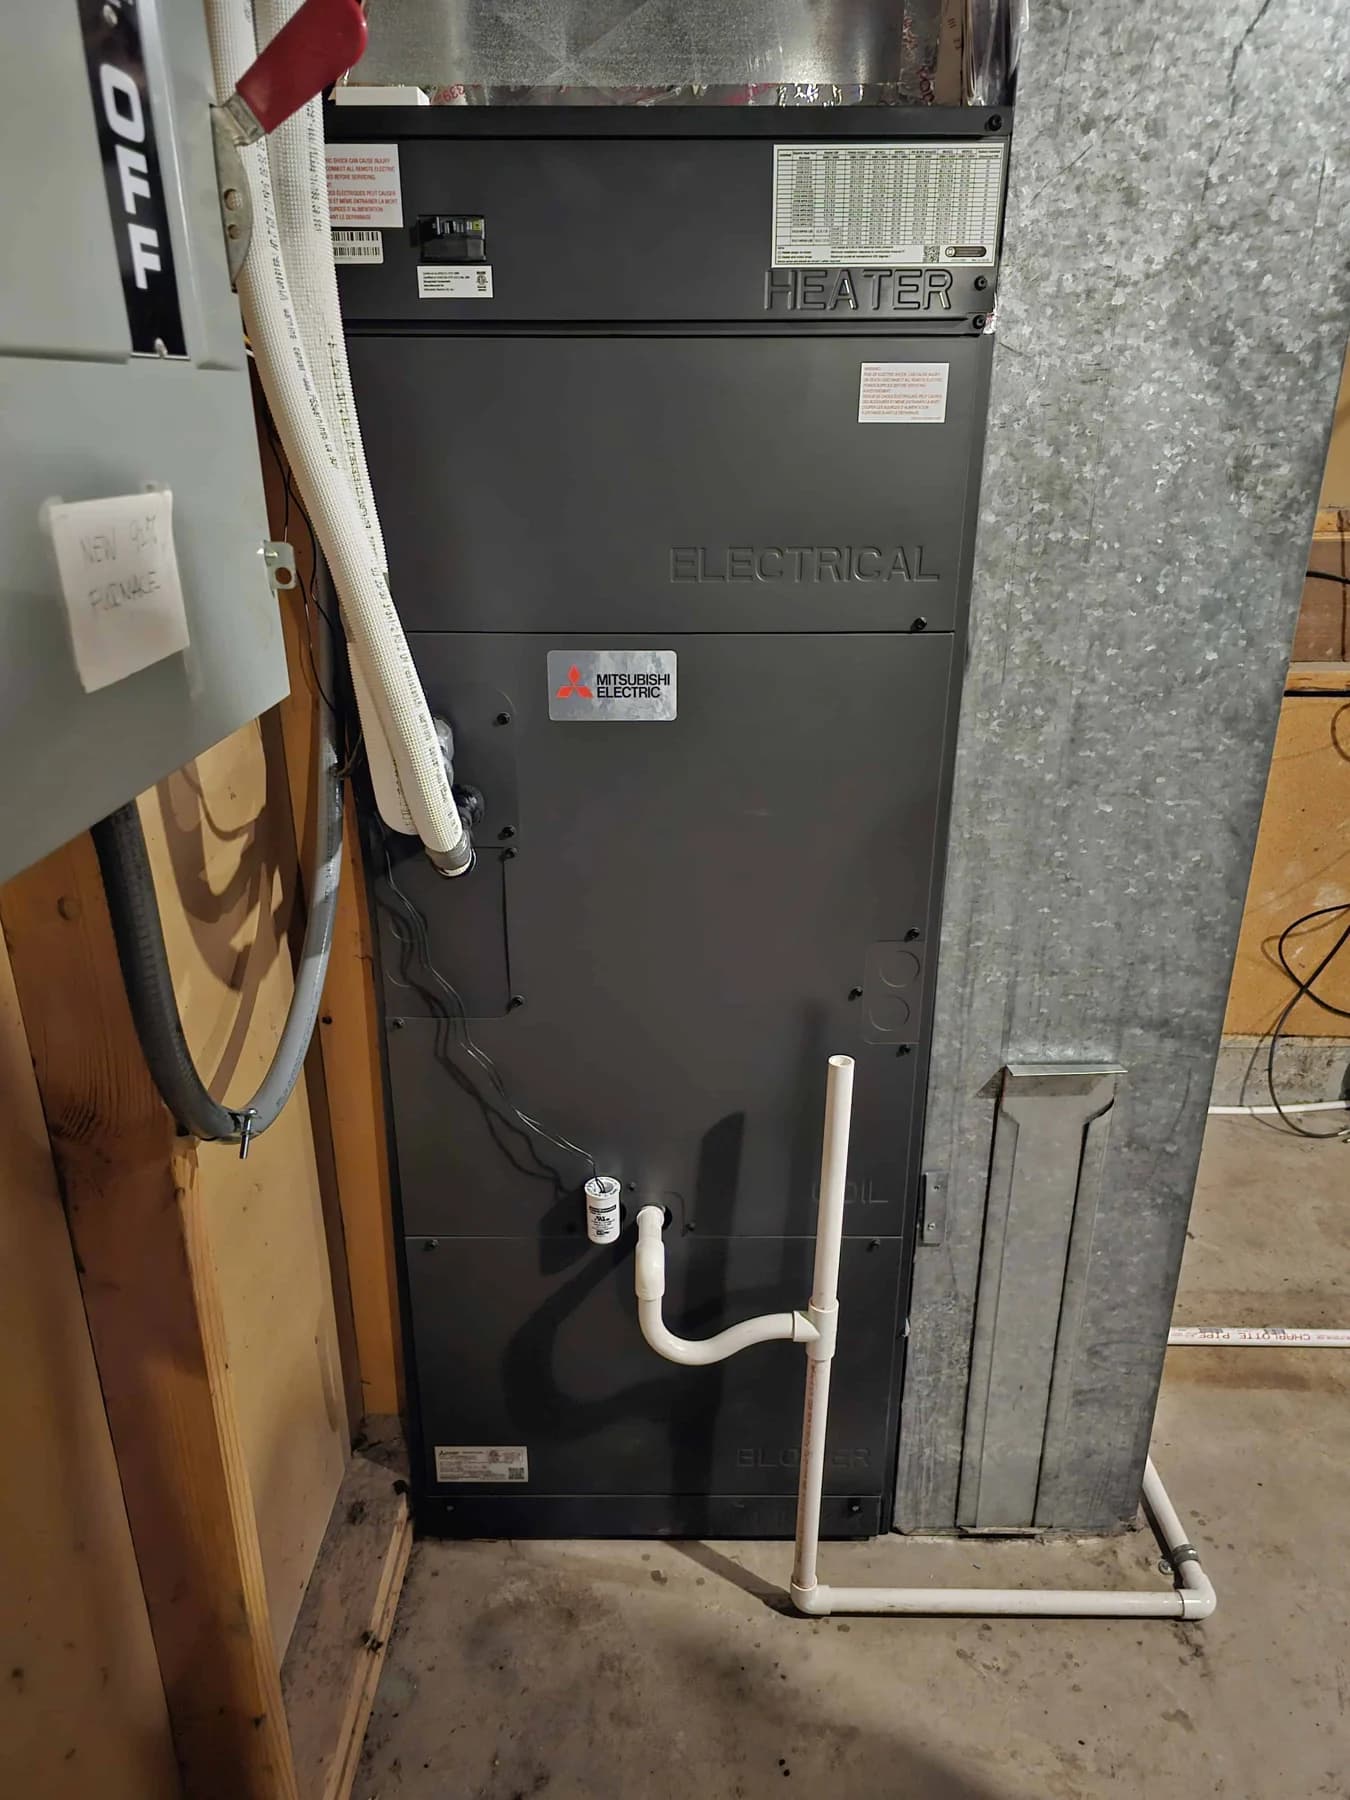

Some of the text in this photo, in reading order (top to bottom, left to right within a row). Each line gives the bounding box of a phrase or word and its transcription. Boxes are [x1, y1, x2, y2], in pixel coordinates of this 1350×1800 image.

[100, 63, 162, 290] OFF
[764, 268, 953, 311] HEATER
[669, 546, 940, 583] ELECTRICAL
[596, 673, 671, 686] MITSUBISHI
[596, 686, 661, 698] ELECTRIC
[1199, 1332, 1231, 1340] PIPE
[1239, 1331, 1312, 1341] CHARLOTTE
[736, 1448, 870, 1469] BLOER
